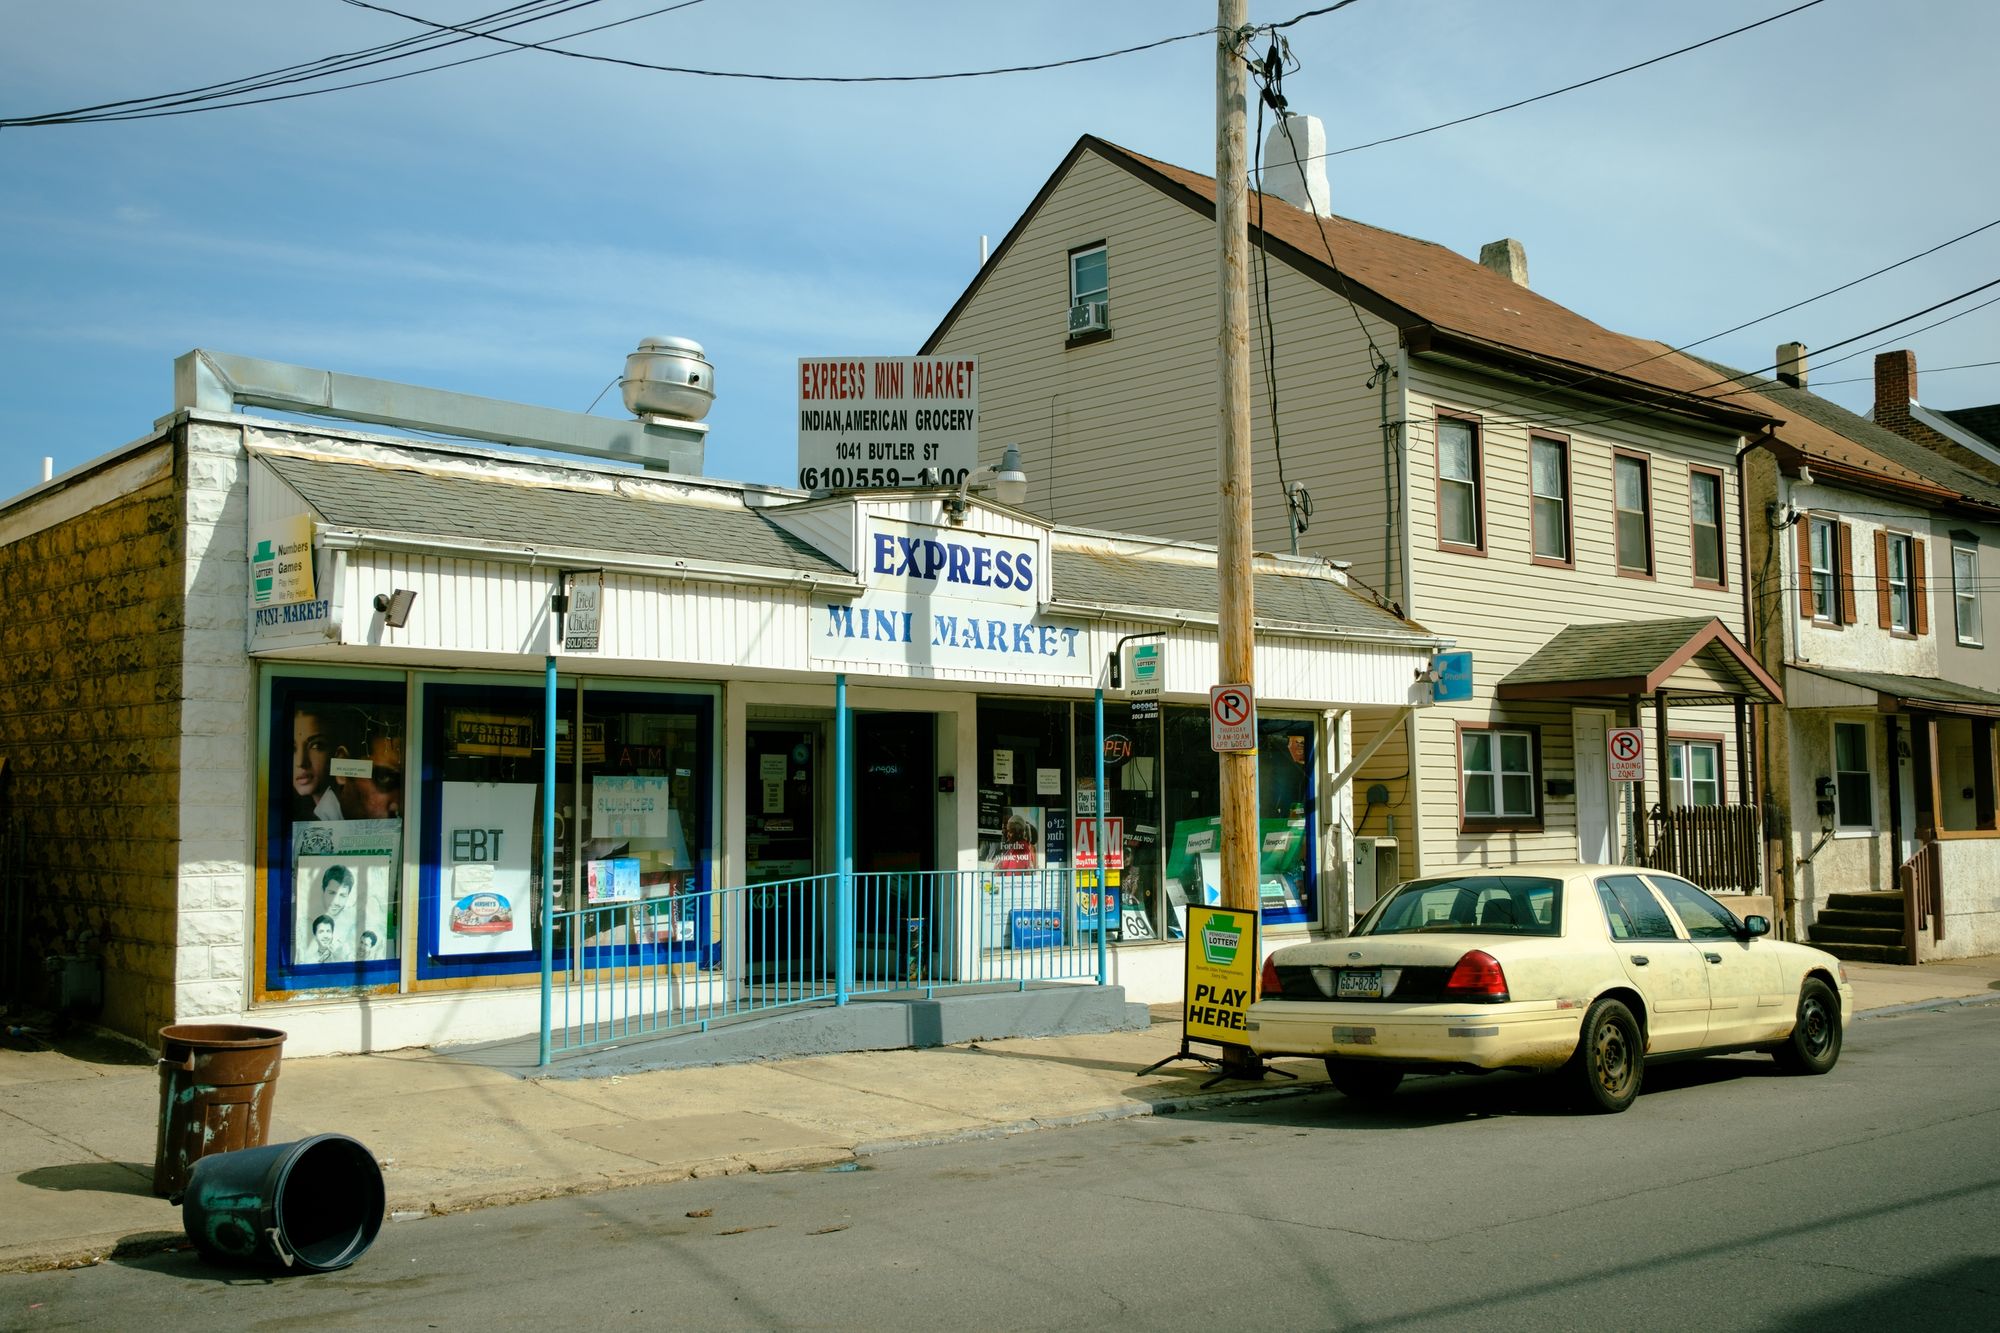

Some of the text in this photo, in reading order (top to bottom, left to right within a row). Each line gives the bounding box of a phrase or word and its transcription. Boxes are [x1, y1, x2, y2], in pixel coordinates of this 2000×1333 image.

[802, 361, 974, 400] EXPRESS MINI MARKET
[801, 409, 974, 435] INDIAN,AMERICAN GROCERY
[836, 443, 939, 460] 1041 BUTLER ST
[800, 467, 970, 490] (610)559-100
[278, 542, 308, 556] Numbers
[278, 561, 302, 574] Games
[873, 533, 1033, 592] EXPRESS
[256, 567, 273, 579] LOTTERY
[575, 591, 596, 612] Fried
[256, 600, 328, 628] MINI-MARKET
[569, 613, 598, 636] Chicken
[826, 605, 1080, 658] MINI MARKET
[567, 638, 598, 648] SOLD HERE
[1144, 687, 1160, 695] HERE!
[460, 723, 518, 736] WESTERN
[478, 734, 518, 745] UNION
[1104, 741, 1132, 757] PEN
[620, 748, 662, 767] ATM
[1078, 792, 1090, 802] Play
[1078, 802, 1090, 812] Win
[452, 829, 504, 862] EBT
[1000, 840, 1025, 850] For the
[1188, 838, 1211, 848] Newport
[1266, 838, 1286, 846] Newport
[996, 853, 1029, 863] whole you
[1209, 938, 1238, 947] LOTTERY
[1195, 984, 1247, 1008] PLAY
[1189, 1005, 1247, 1031] HERE!
